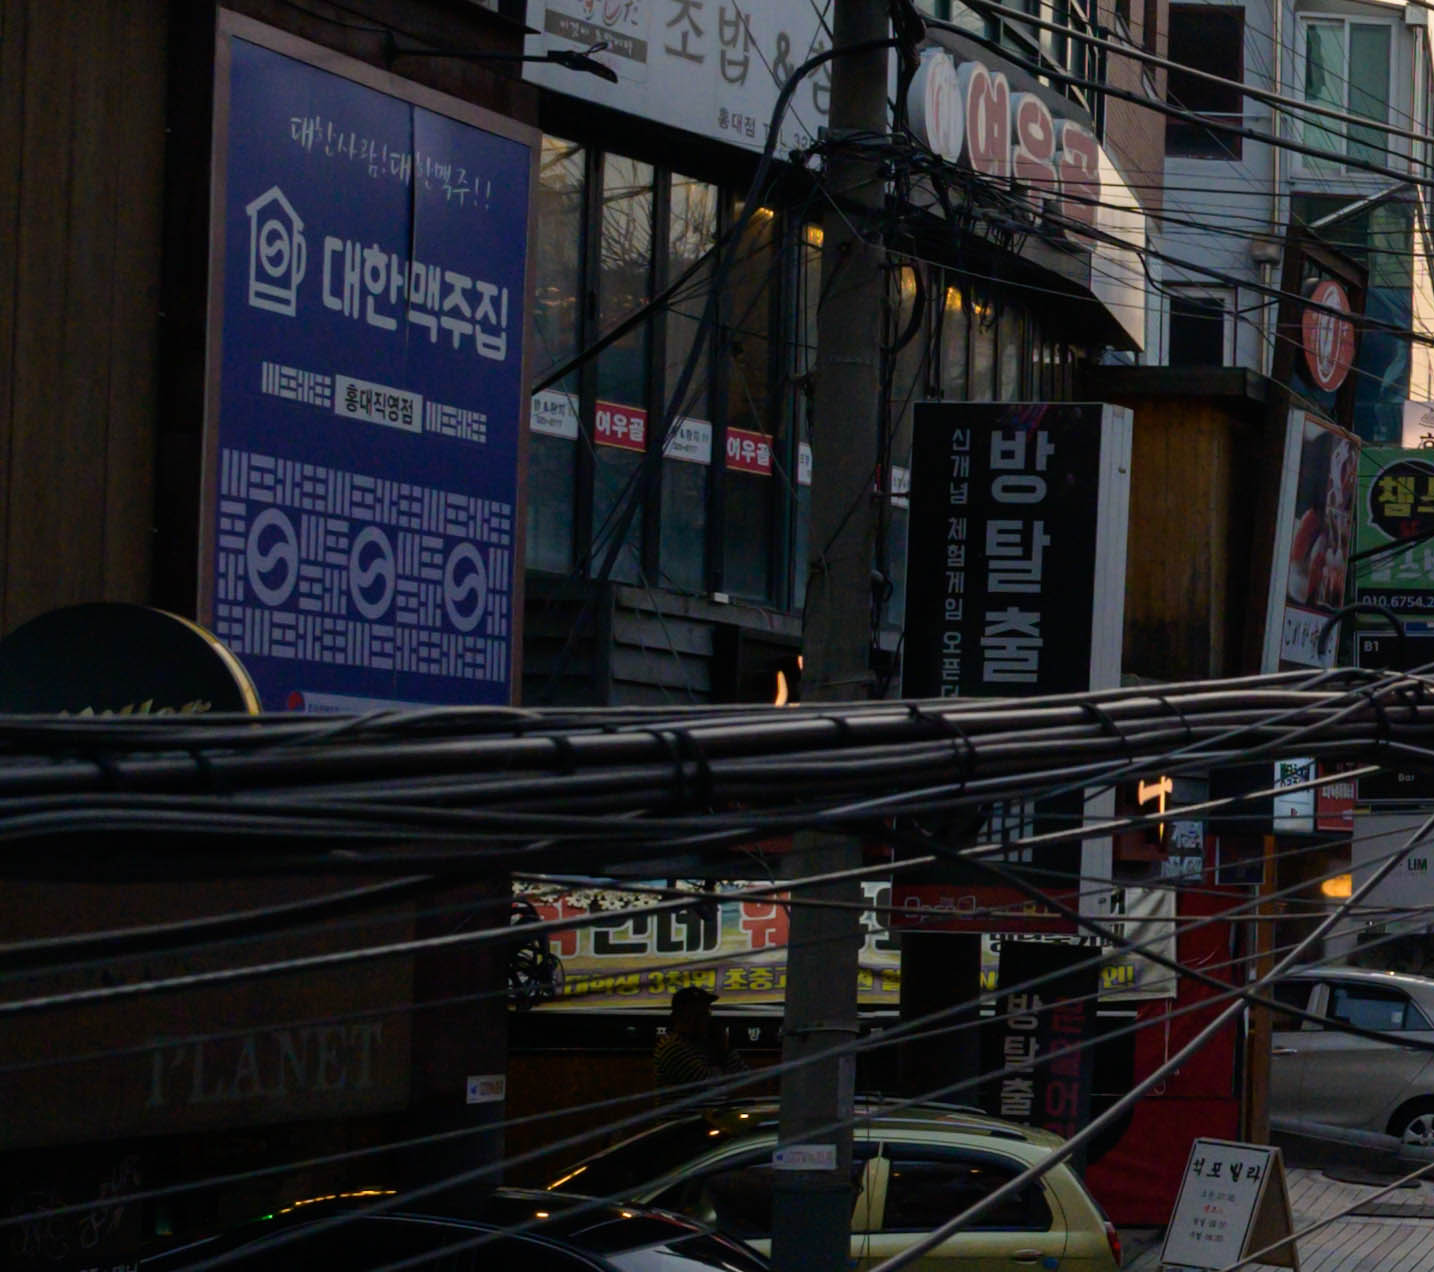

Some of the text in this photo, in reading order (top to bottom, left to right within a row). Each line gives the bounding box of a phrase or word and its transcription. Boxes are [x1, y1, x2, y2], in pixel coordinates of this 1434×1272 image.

[321, 234, 509, 362] 대한맥주집
[343, 382, 414, 426] 홍대직영점
[979, 430, 1057, 684] 방탈출
[1363, 638, 1381, 654] B1
[1407, 857, 1428, 872] LIM
[146, 1023, 383, 1107] PLANET
